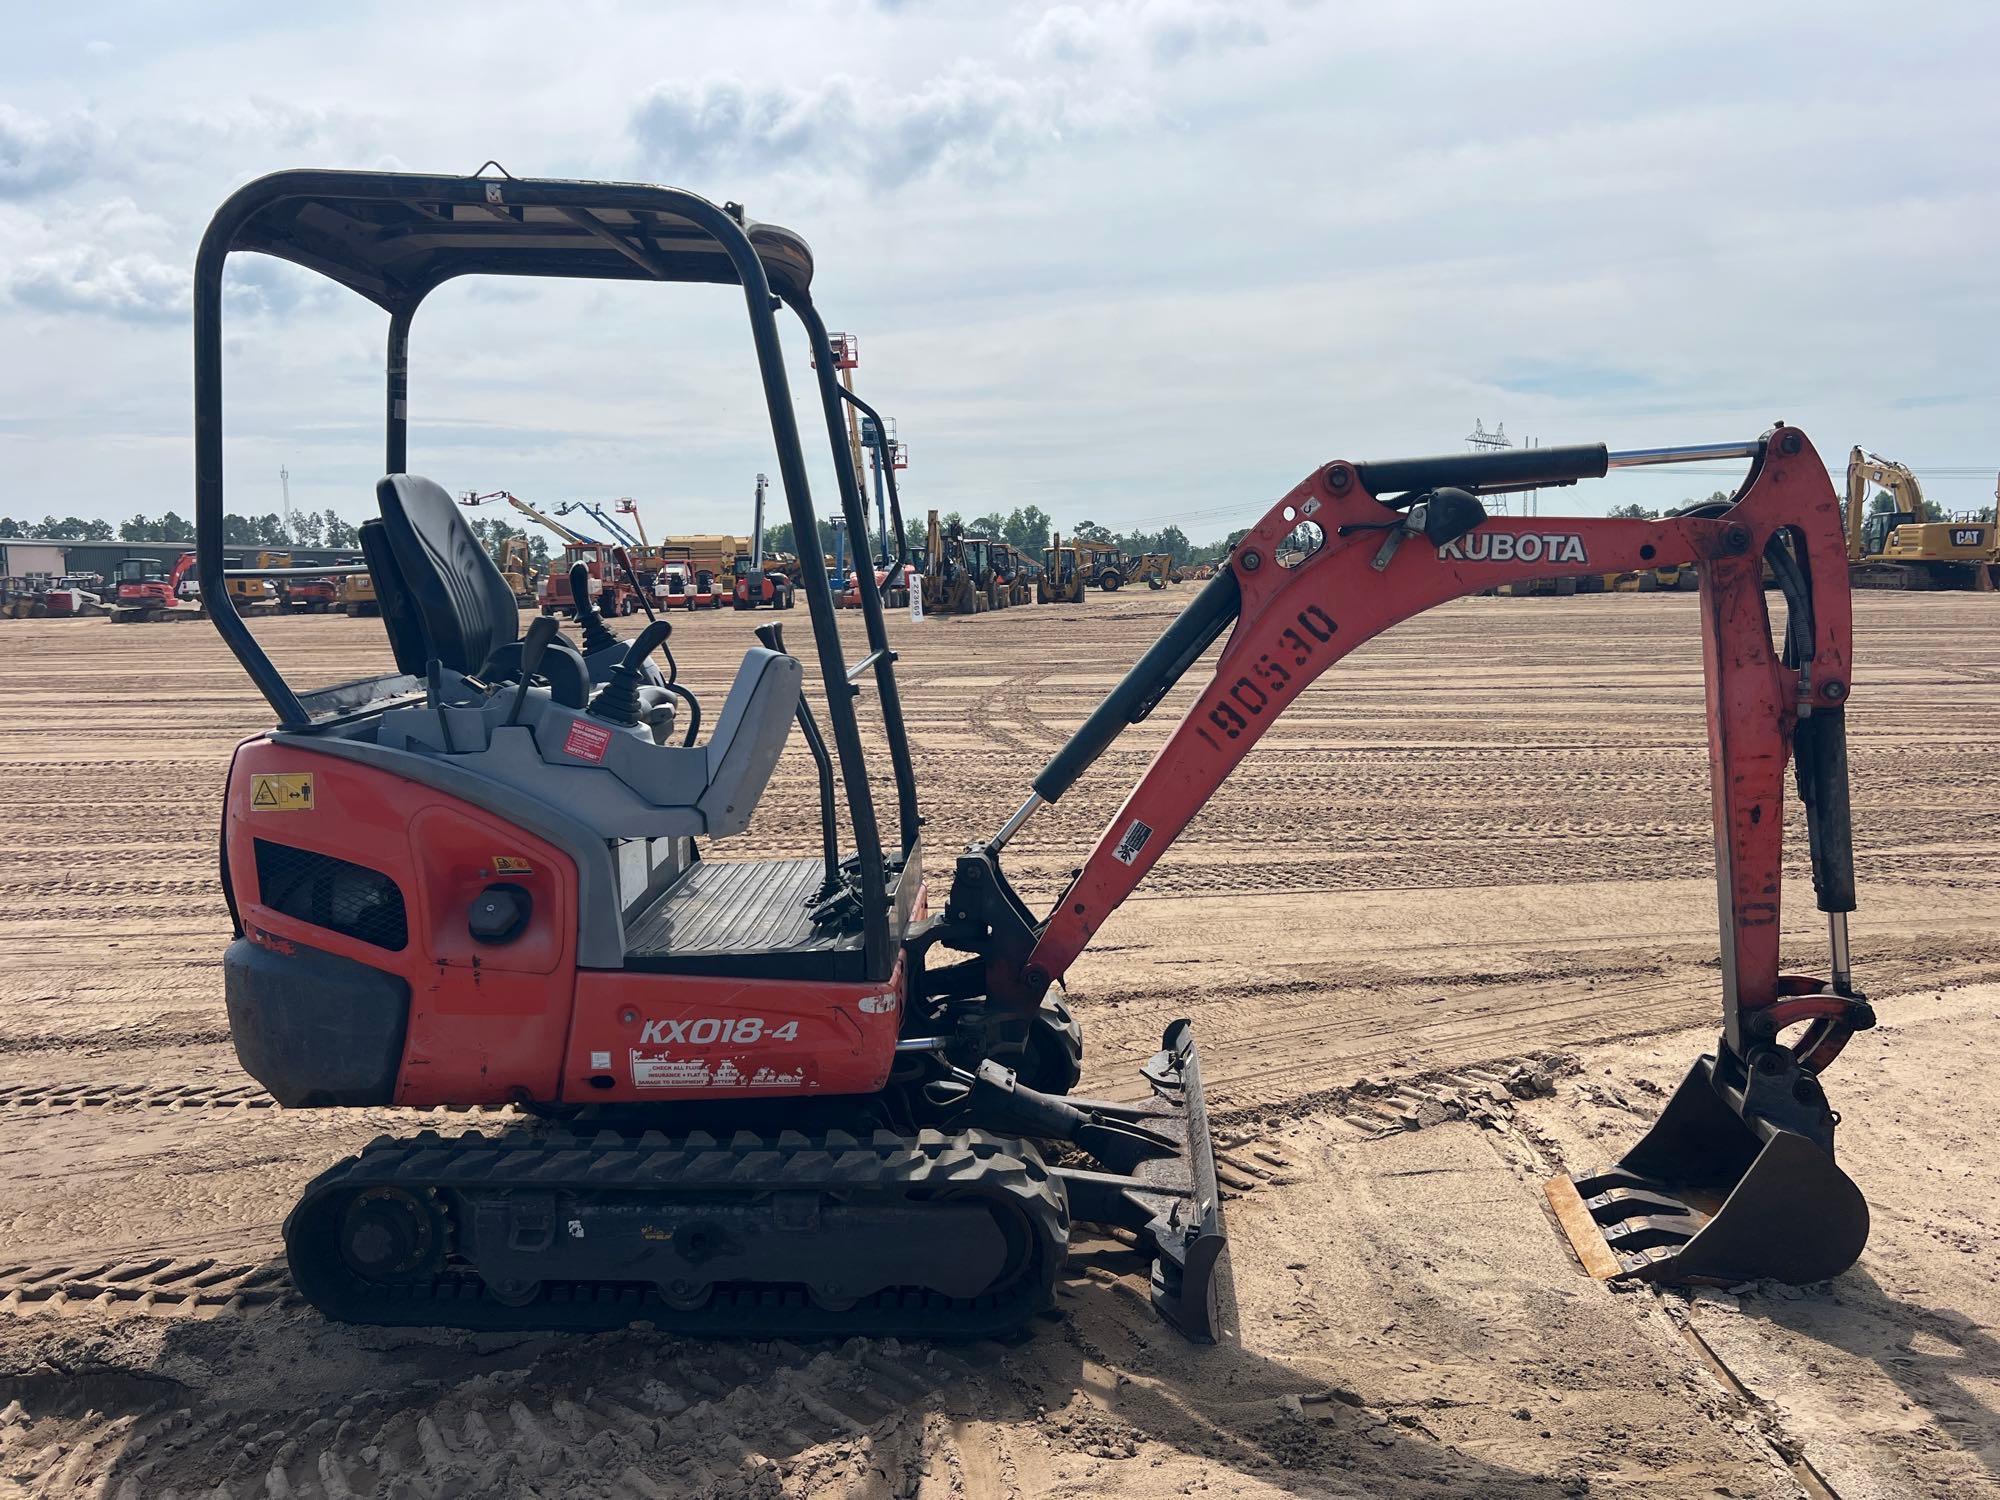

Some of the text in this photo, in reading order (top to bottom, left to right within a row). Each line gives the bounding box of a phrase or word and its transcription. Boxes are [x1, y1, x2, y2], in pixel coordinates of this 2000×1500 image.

[1438, 533, 1585, 562] KUBOTA
[1956, 530, 1979, 544] CAT
[639, 1017, 799, 1044] KX018-4
